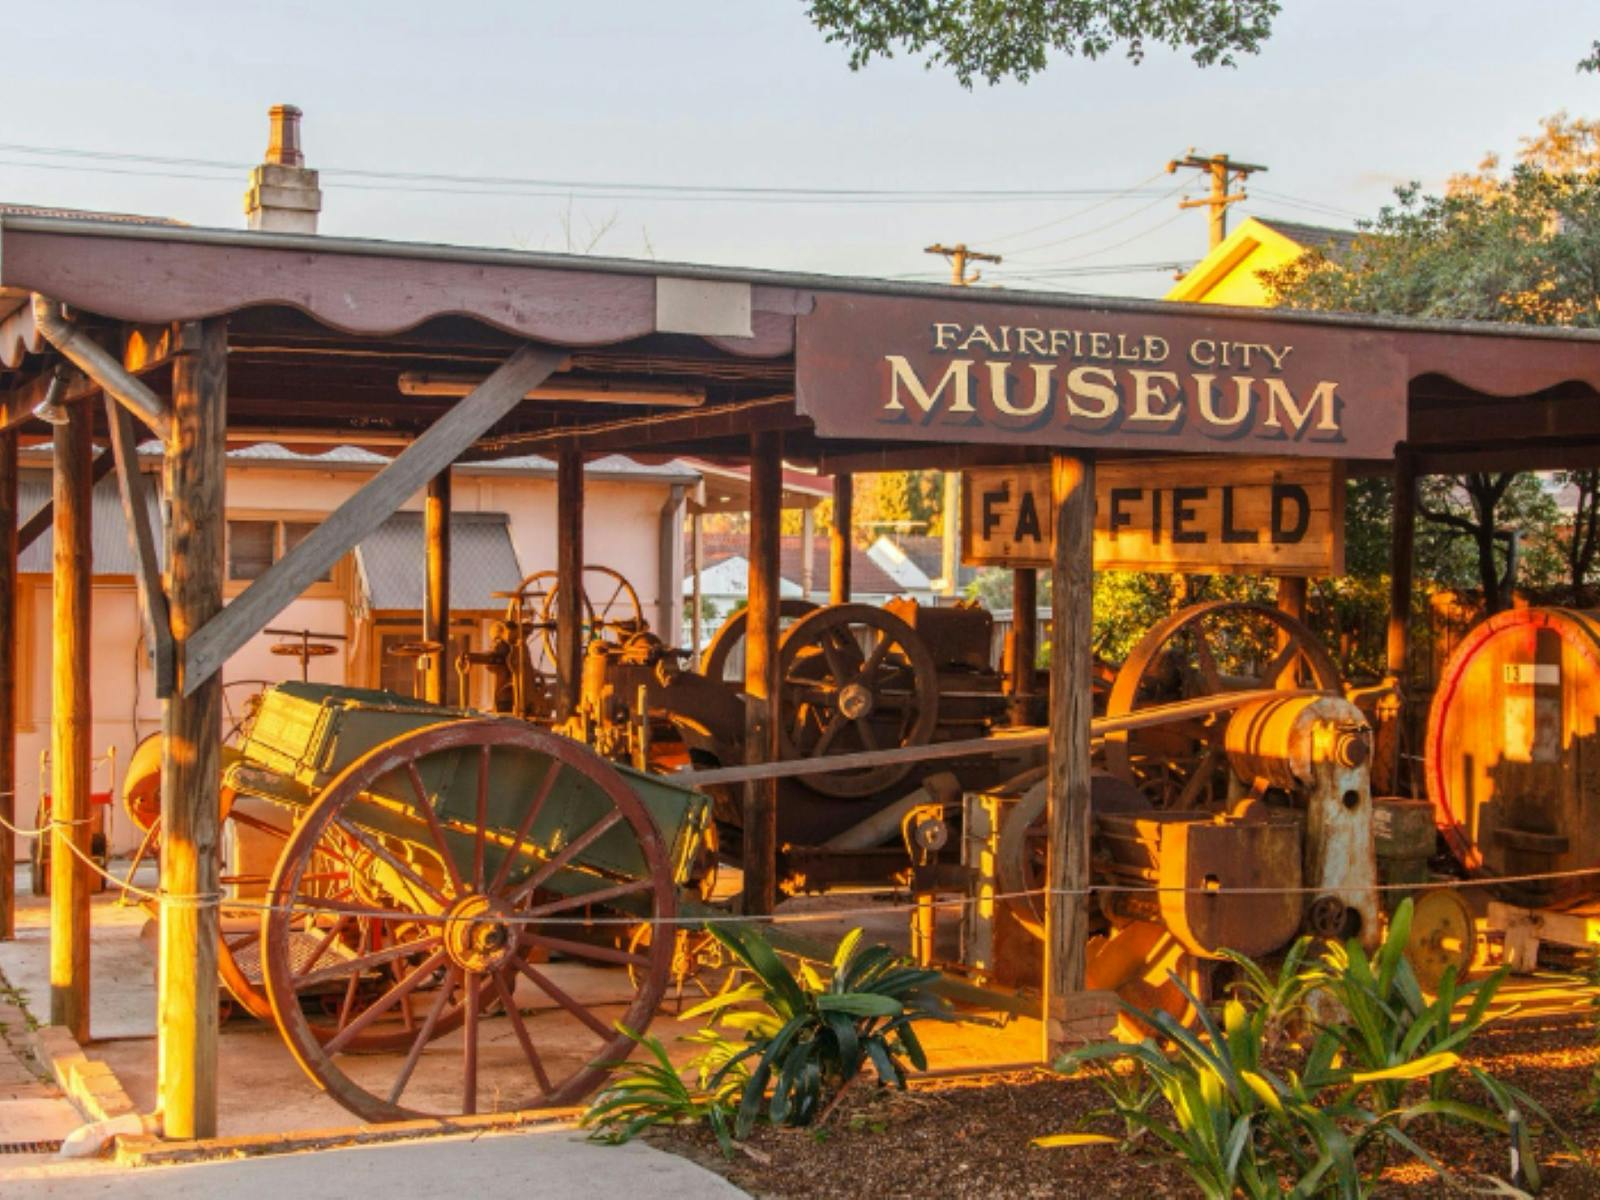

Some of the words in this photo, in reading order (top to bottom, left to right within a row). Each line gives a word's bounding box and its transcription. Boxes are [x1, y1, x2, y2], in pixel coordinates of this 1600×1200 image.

[932, 322, 1170, 362] FAIRFIELD
[1189, 339, 1294, 370] CITY
[884, 355, 1340, 431] MUSEUM
[982, 484, 1312, 545] FAFIELD
